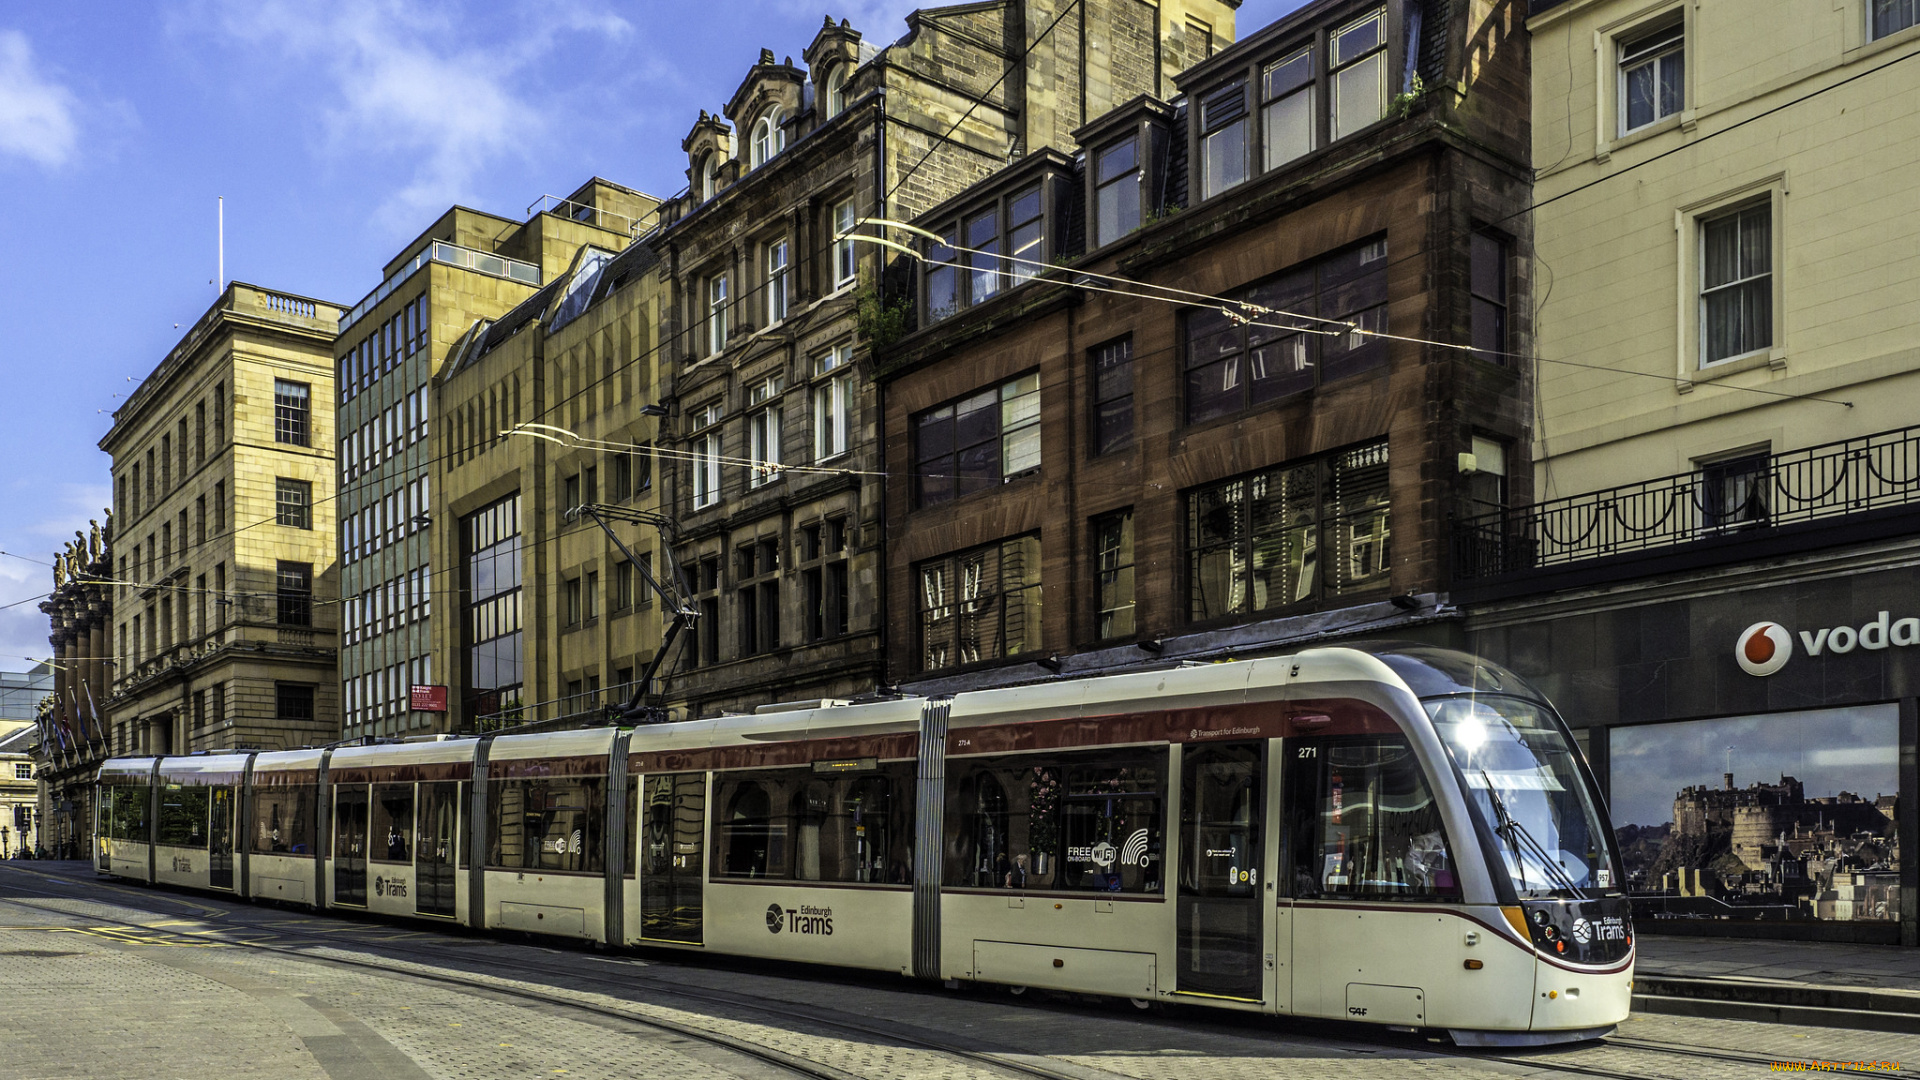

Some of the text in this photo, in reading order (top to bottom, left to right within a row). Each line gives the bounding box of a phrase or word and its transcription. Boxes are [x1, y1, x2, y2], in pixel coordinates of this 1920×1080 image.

[1798, 610, 1920, 657] voda
[1198, 729, 1223, 737] Transport
[1232, 726, 1260, 735] Edinburgh
[1298, 747, 1317, 758] 271
[1068, 847, 1091, 856] FREE
[1599, 874, 1608, 882] 957
[385, 880, 407, 897] Trams
[801, 905, 832, 917] Edinburgh
[786, 909, 833, 936] Trams
[1603, 917, 1623, 925] Edinburgh
[1592, 921, 1625, 940] Trams
[1348, 1006, 1367, 1016] CAF
